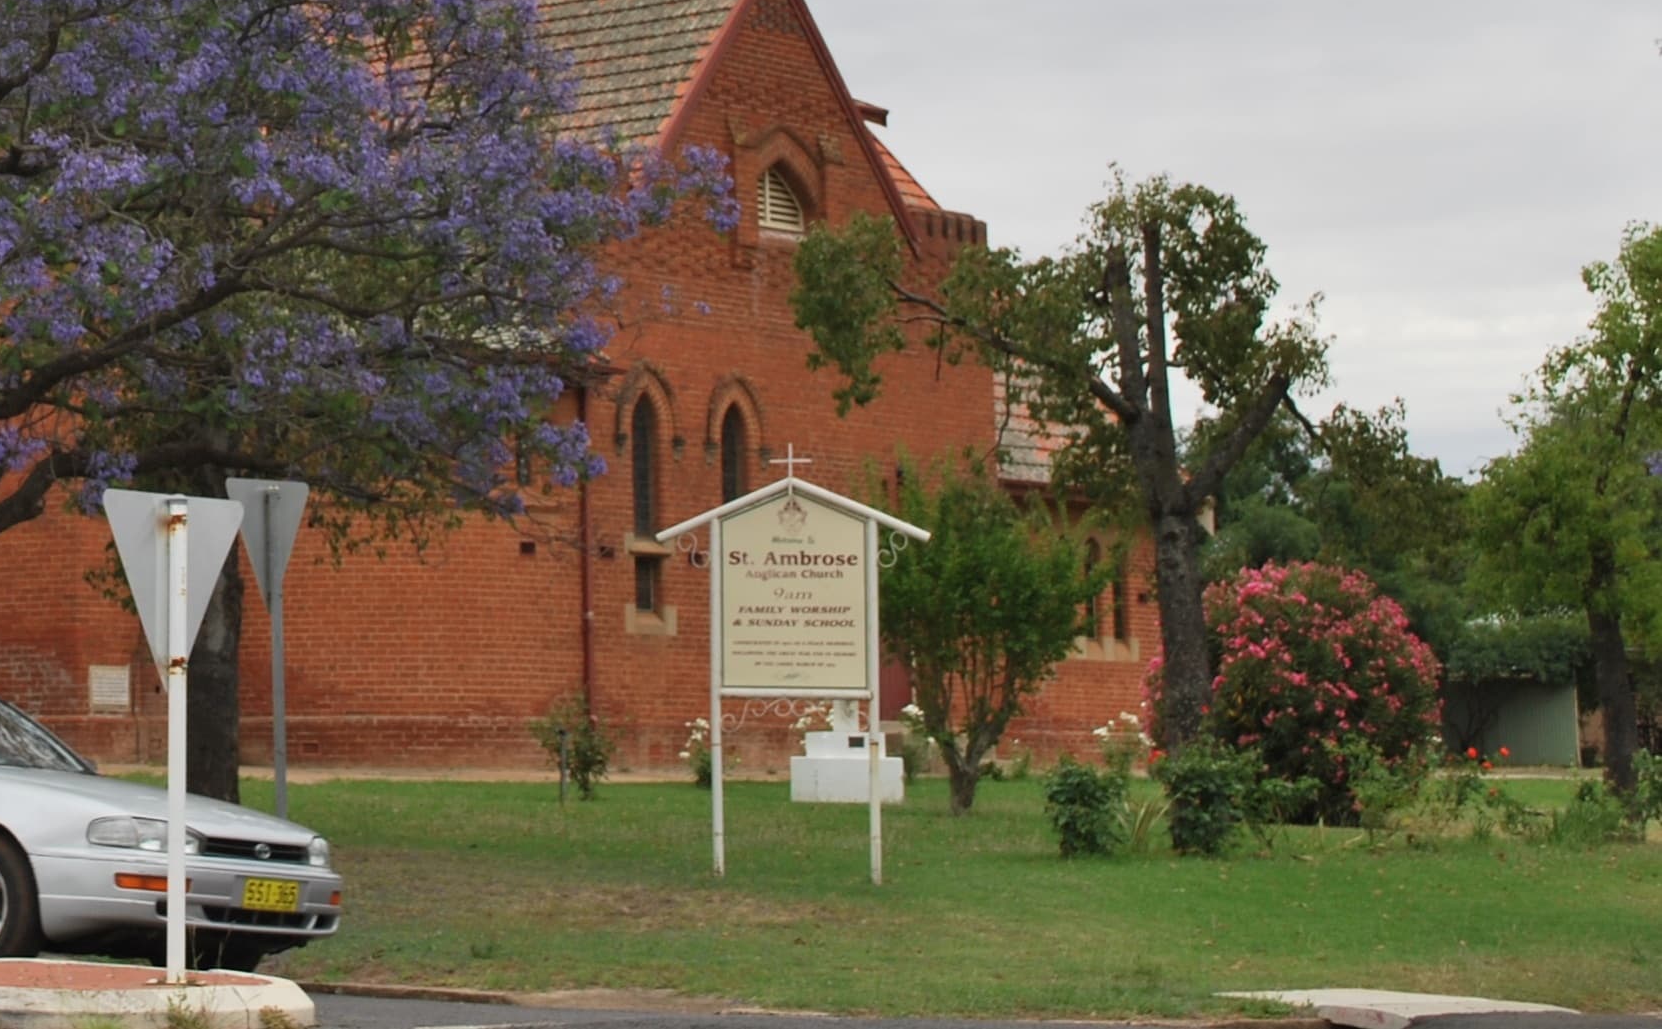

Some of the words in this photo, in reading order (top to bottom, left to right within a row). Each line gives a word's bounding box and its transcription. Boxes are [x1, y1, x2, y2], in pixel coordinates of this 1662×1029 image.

[729, 551, 754, 565] St.
[764, 551, 858, 565] Ambrose
[745, 569, 797, 581] Anglican
[800, 569, 844, 579] Church
[738, 605, 785, 614] FAMILY
[789, 605, 852, 614] WORSHIP
[747, 619, 799, 627] SUNDAY
[804, 619, 856, 627] SCHOOL
